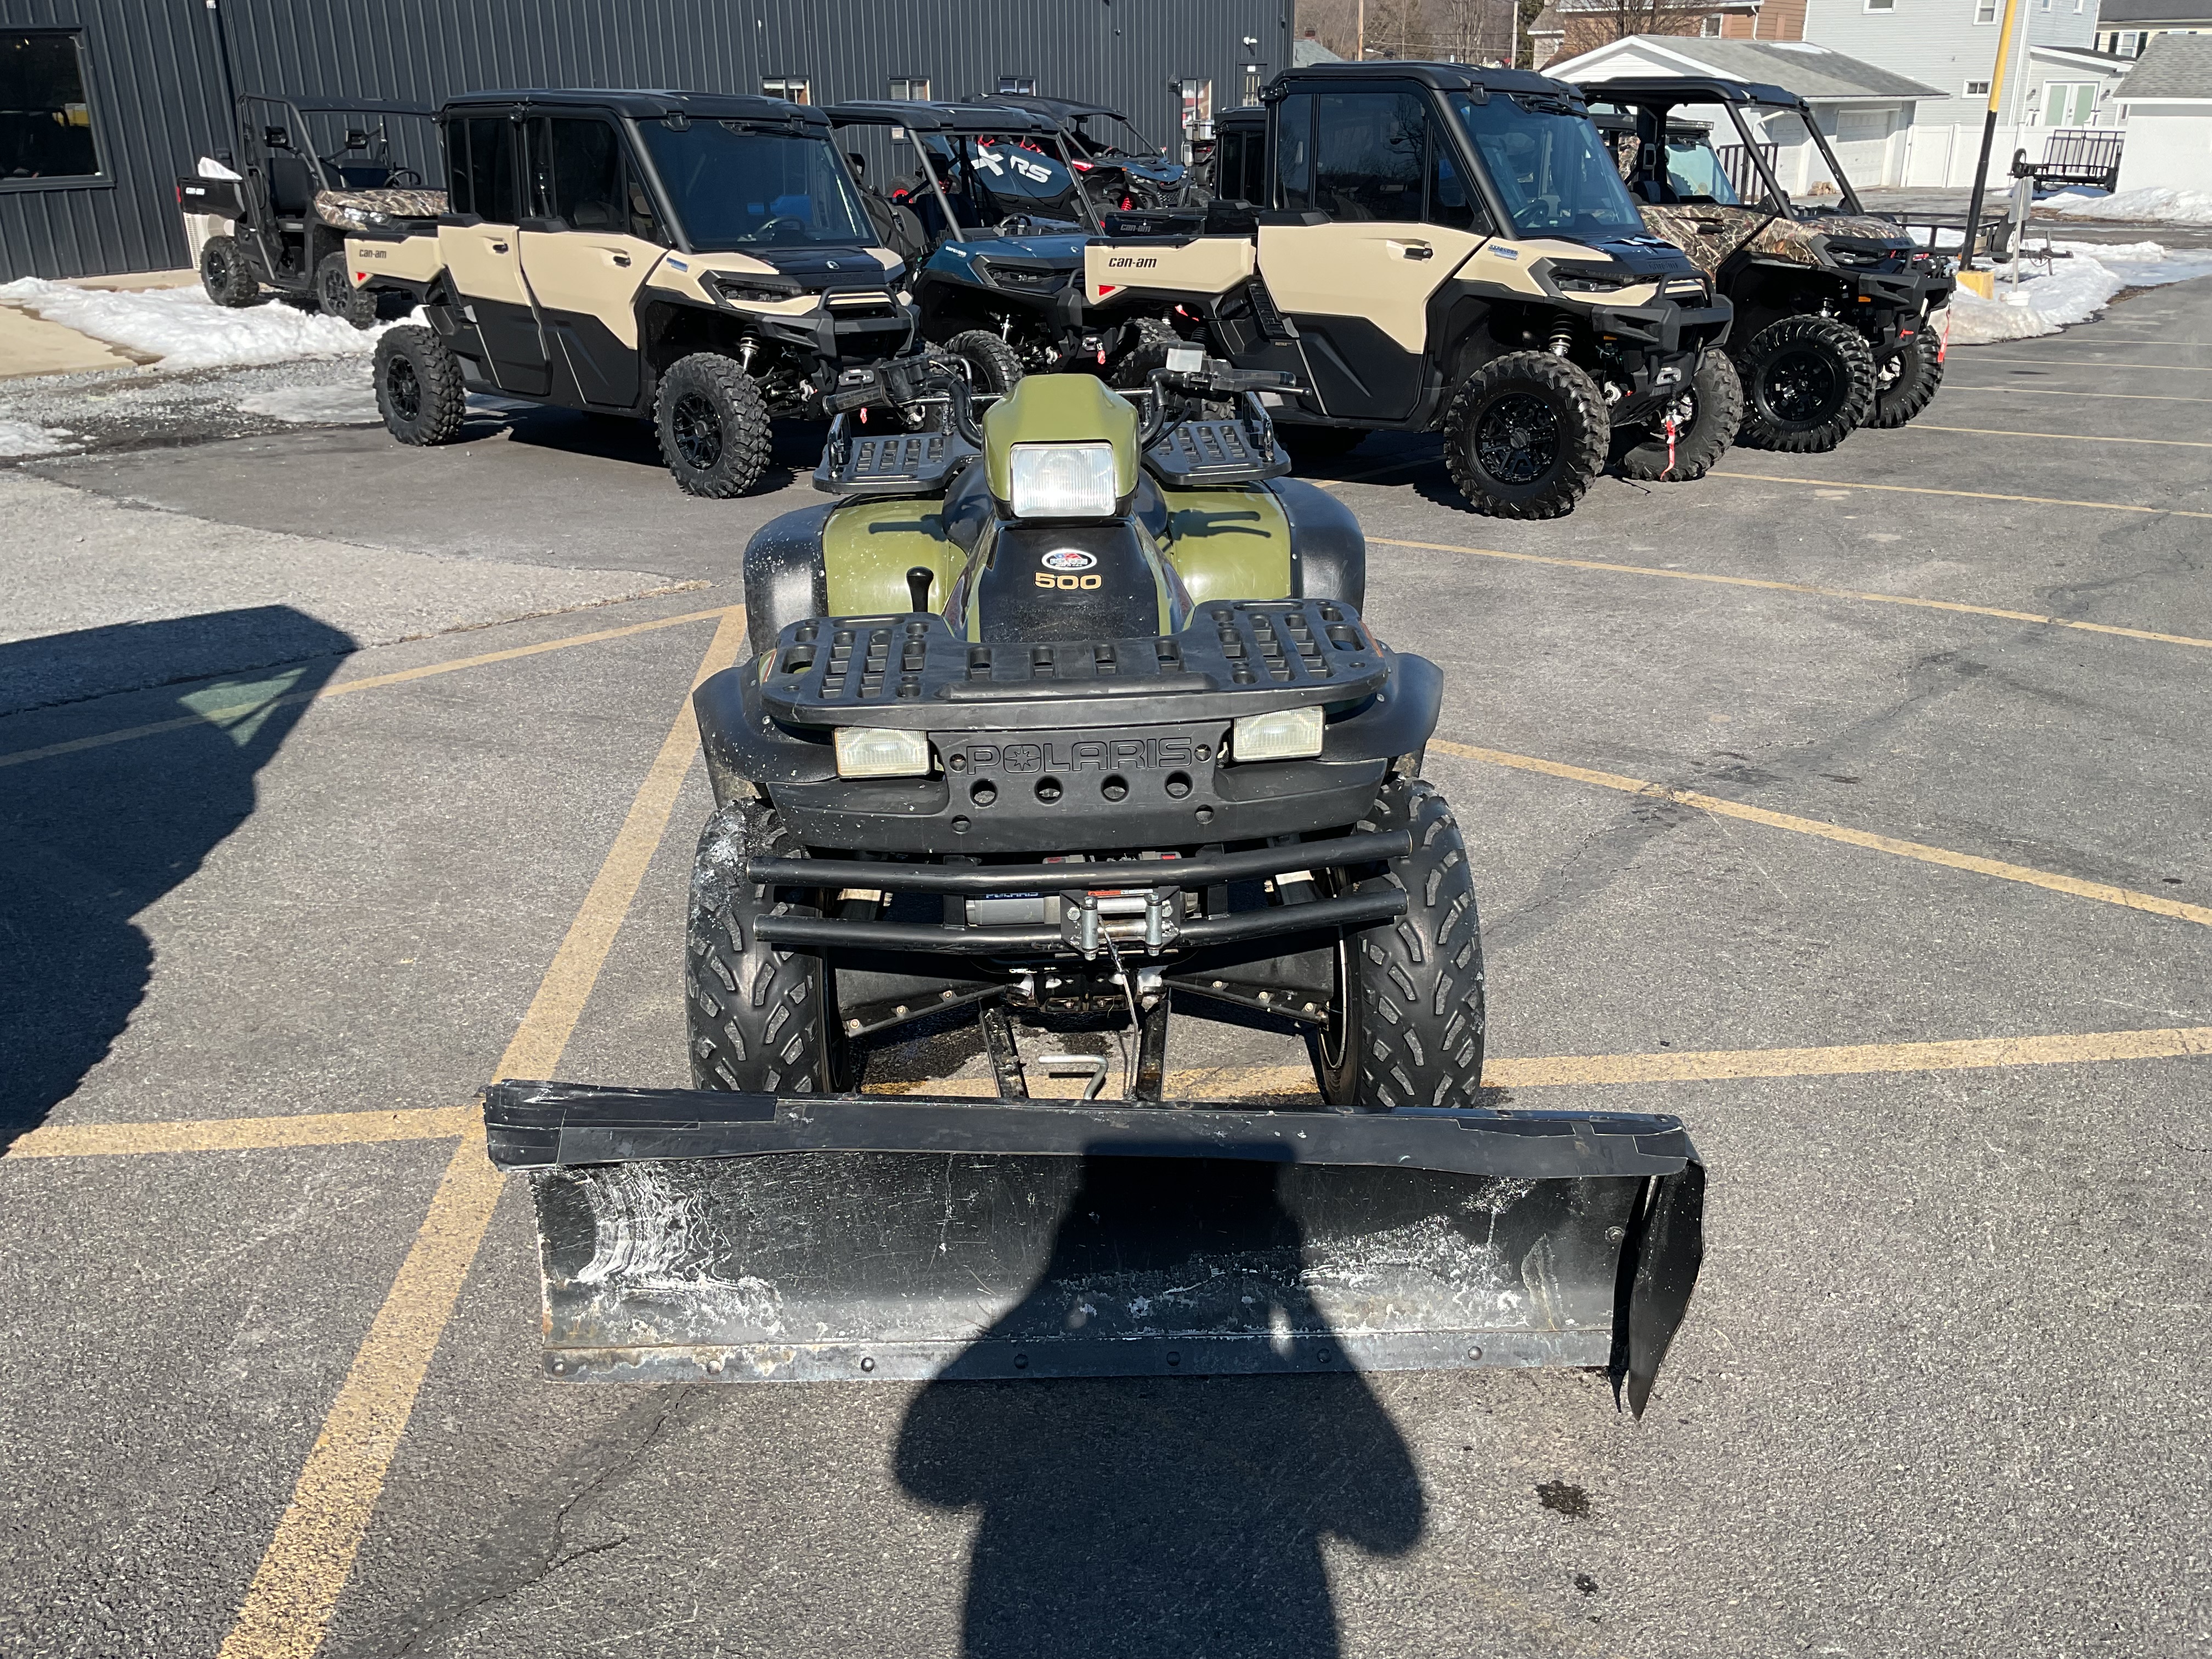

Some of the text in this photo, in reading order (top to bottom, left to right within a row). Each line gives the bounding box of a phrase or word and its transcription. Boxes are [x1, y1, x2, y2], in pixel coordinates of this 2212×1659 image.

[971, 144, 1052, 183] X RS
[1120, 224, 1152, 233] can-am
[359, 249, 387, 259] can-am
[1108, 258, 1157, 268] can-am
[1034, 571, 1102, 590] 500
[966, 737, 1192, 775] POLARIS
